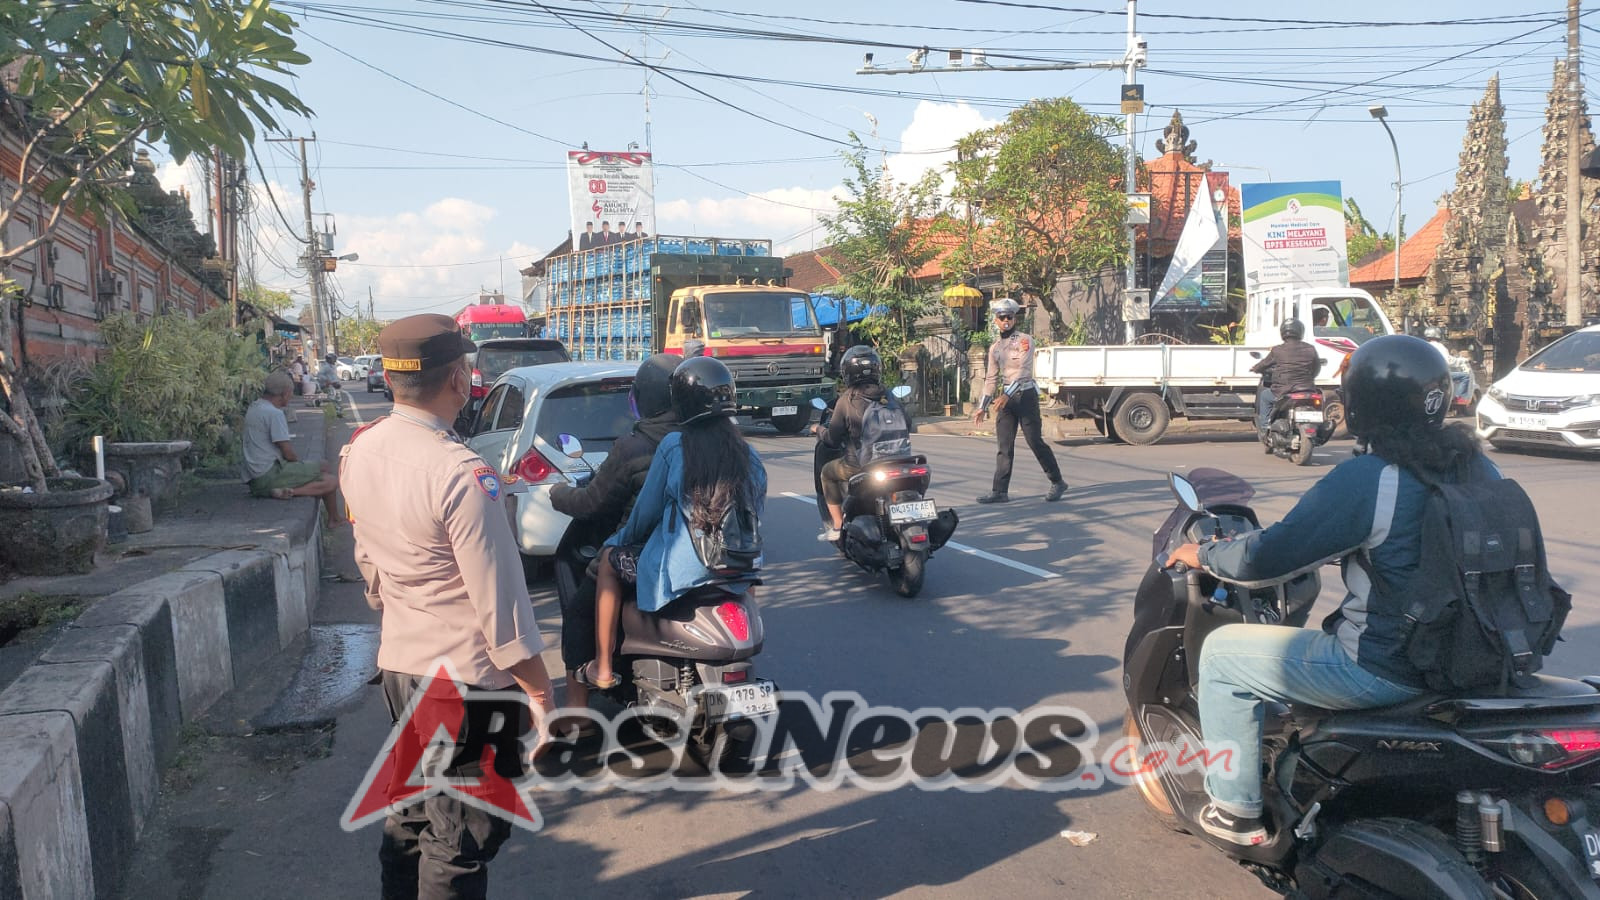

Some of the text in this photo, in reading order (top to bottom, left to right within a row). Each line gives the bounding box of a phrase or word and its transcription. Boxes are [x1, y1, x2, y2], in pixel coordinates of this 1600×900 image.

[1267, 229, 1324, 239] KINI MELAYANI
[1265, 239, 1327, 249] BPJS KESEHATAN
[709, 694, 723, 706] DK
[760, 685, 770, 698] SP
